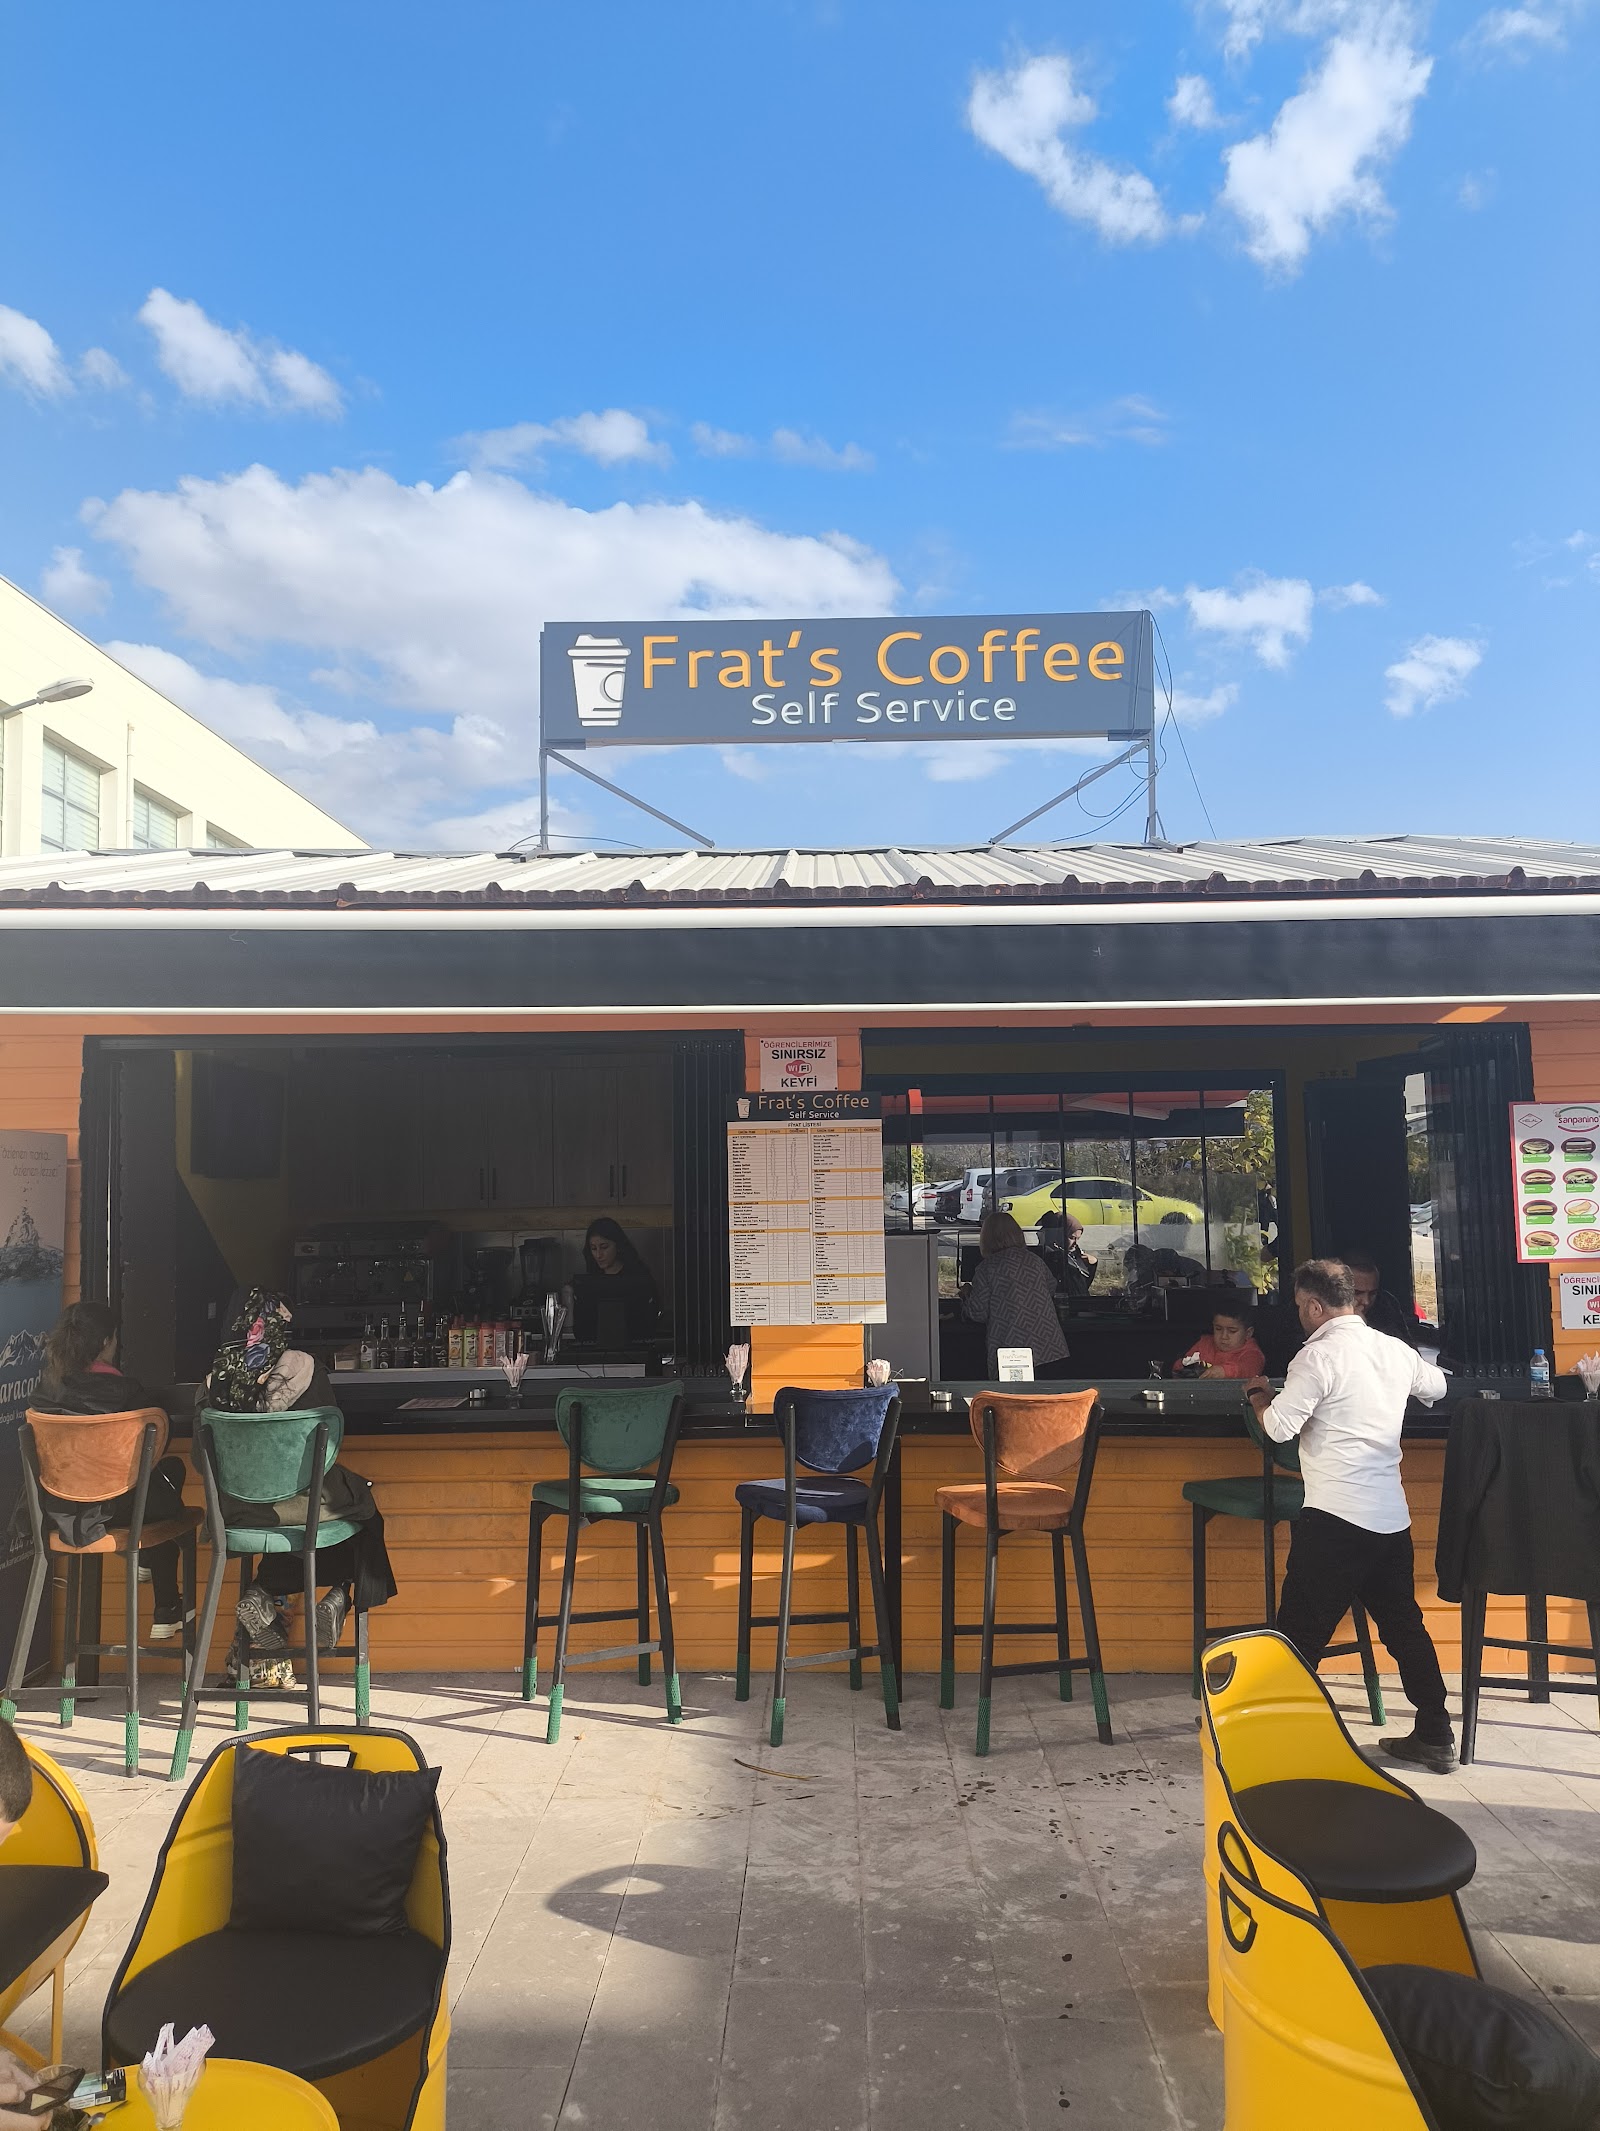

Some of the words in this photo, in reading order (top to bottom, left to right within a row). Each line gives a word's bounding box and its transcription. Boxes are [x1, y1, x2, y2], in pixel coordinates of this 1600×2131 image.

[641, 630, 844, 689] Frat's
[876, 627, 1126, 687] Coffee
[750, 691, 840, 727] Self
[856, 689, 1017, 724] Service
[771, 1048, 826, 1060] SINIRSIZ
[781, 1075, 818, 1088] KEYFİ
[757, 1094, 806, 1110] Frat's
[812, 1094, 870, 1109] Coffee
[789, 1110, 806, 1119] Self
[808, 1110, 840, 1119] Service
[1558, 1116, 1600, 1126] sanpanino
